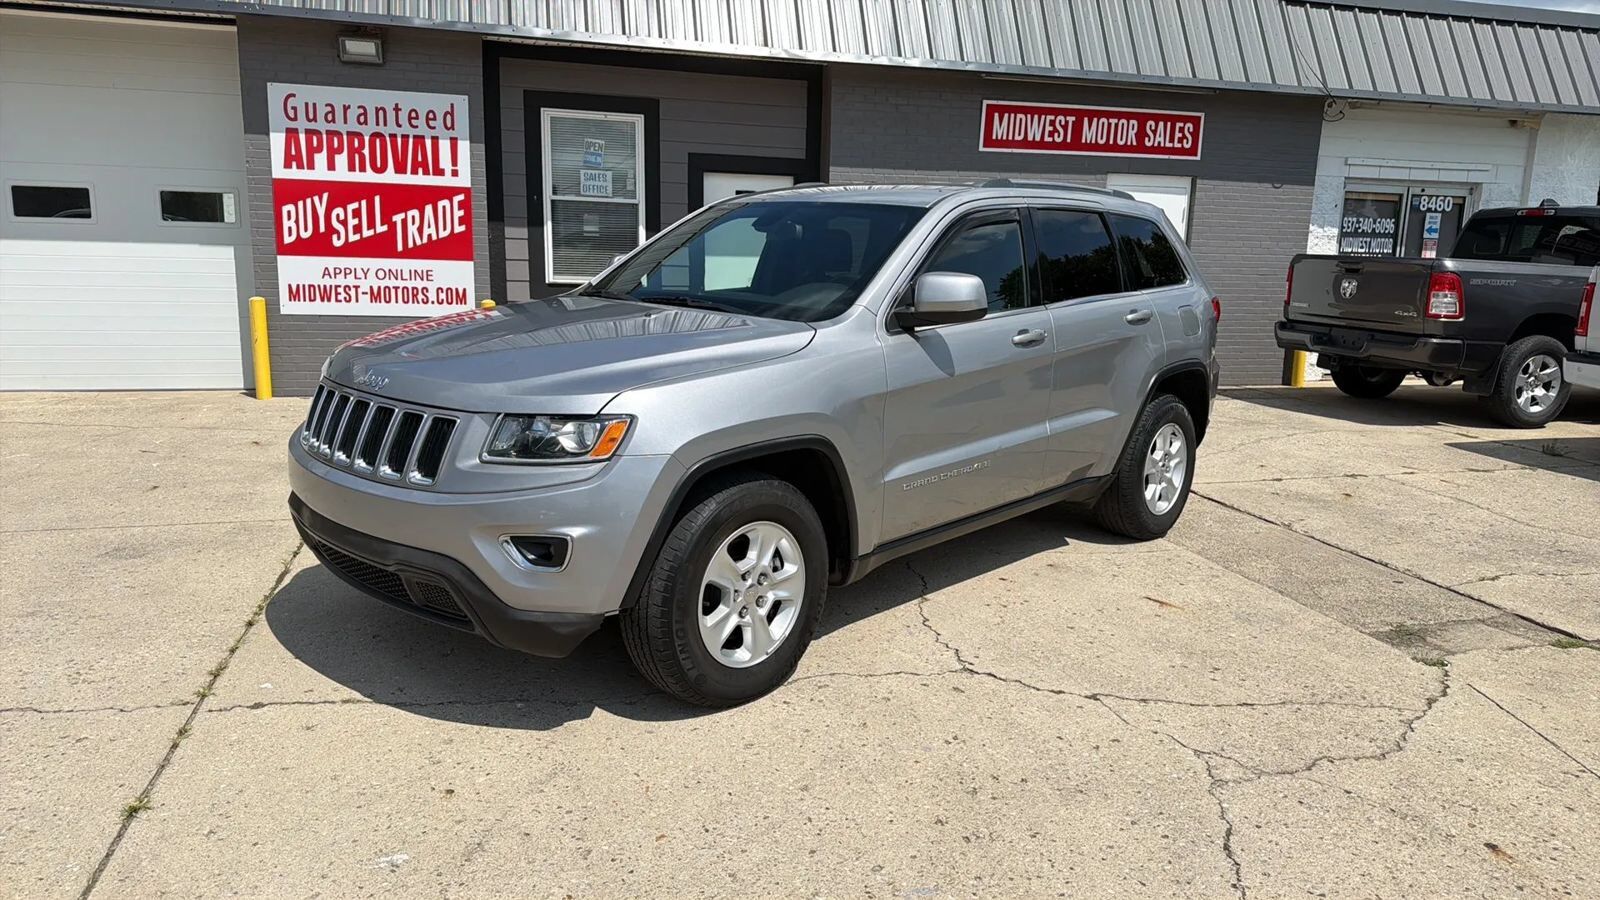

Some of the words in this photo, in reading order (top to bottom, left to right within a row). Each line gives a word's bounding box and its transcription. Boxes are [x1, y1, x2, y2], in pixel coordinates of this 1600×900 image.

[283, 93, 455, 131] Guaranteed
[992, 112, 1076, 143] MIDWEST
[1081, 117, 1138, 146] MOTOR
[1144, 120, 1193, 149] SALES
[283, 127, 459, 177] APPROVAL!
[585, 140, 603, 152] OPEN
[583, 172, 608, 182] SALES
[582, 183, 609, 194] OFFICE
[1419, 195, 1453, 212] 8460
[282, 192, 329, 244] BUY
[331, 195, 388, 247] SELL
[392, 193, 466, 252] TRADE
[1342, 217, 1395, 234] 937-340-6096
[1340, 237, 1370, 253] MIDWEST
[1370, 238, 1393, 253] MOTOR
[321, 266, 370, 280] APPLY
[375, 268, 434, 282] ONLINE
[288, 283, 467, 306] MIDWEST-MOTORS.COM
[903, 475, 938, 491] GRAND
